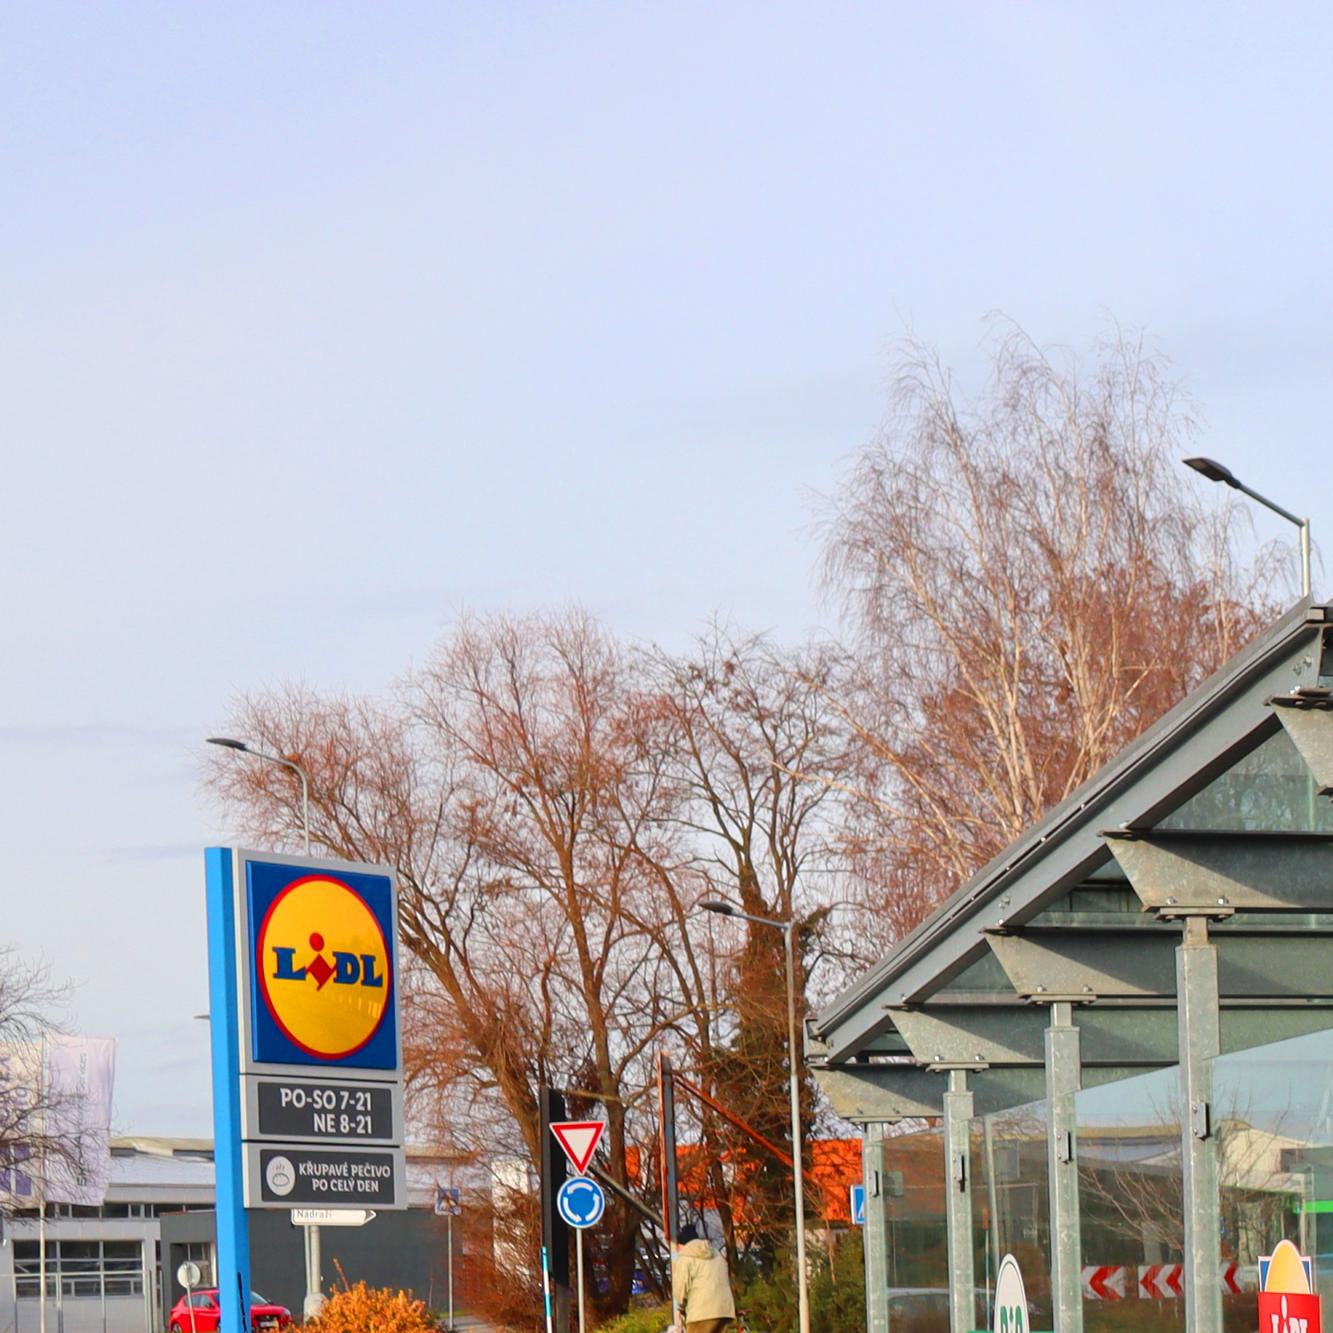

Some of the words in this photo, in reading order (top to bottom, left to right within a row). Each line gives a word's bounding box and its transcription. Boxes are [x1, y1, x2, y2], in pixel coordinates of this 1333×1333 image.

[280, 1088, 336, 1110] PO-SO
[340, 1091, 372, 1111] 7-21
[313, 1113, 336, 1133] NE
[340, 1114, 372, 1134] 8-21
[299, 1161, 349, 1177] KŘUPAVÉ
[351, 1163, 391, 1178] PEČIVO
[312, 1178, 328, 1191] PO
[330, 1177, 355, 1192] CELÝ
[357, 1180, 379, 1192] DEN
